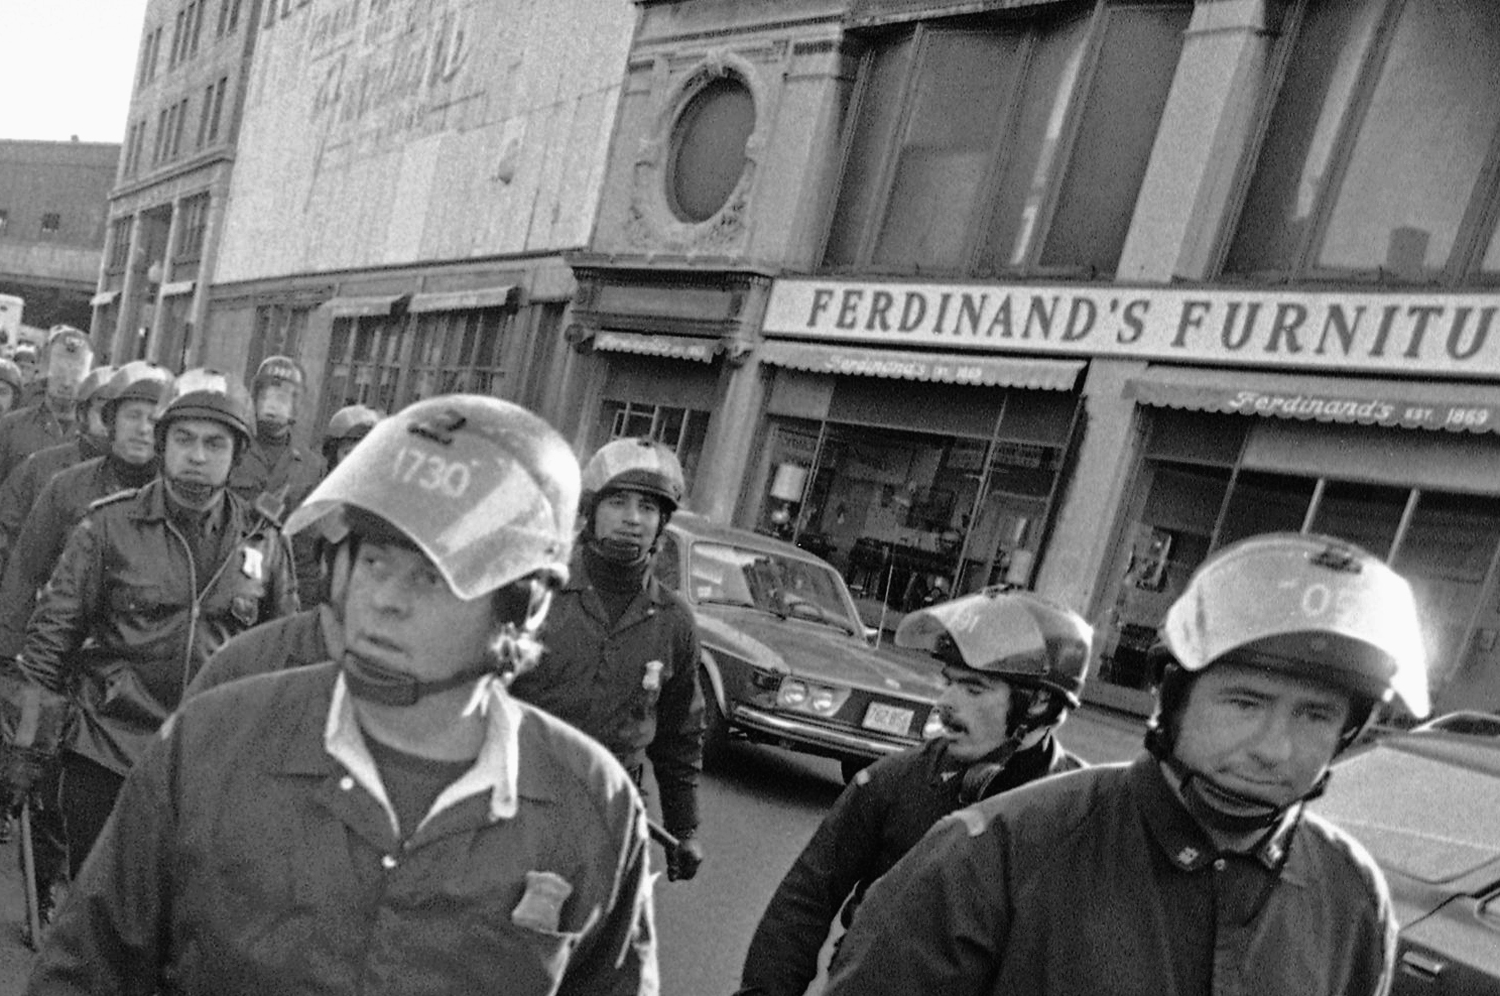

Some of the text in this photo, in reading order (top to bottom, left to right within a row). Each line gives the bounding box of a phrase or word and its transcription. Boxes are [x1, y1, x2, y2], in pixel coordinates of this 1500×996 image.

[806, 288, 1499, 361] FERDINAND'S FURNITU
[1228, 391, 1394, 420] Ferdinand's
[1446, 407, 1488, 426] 1869
[393, 446, 470, 498] 1730
